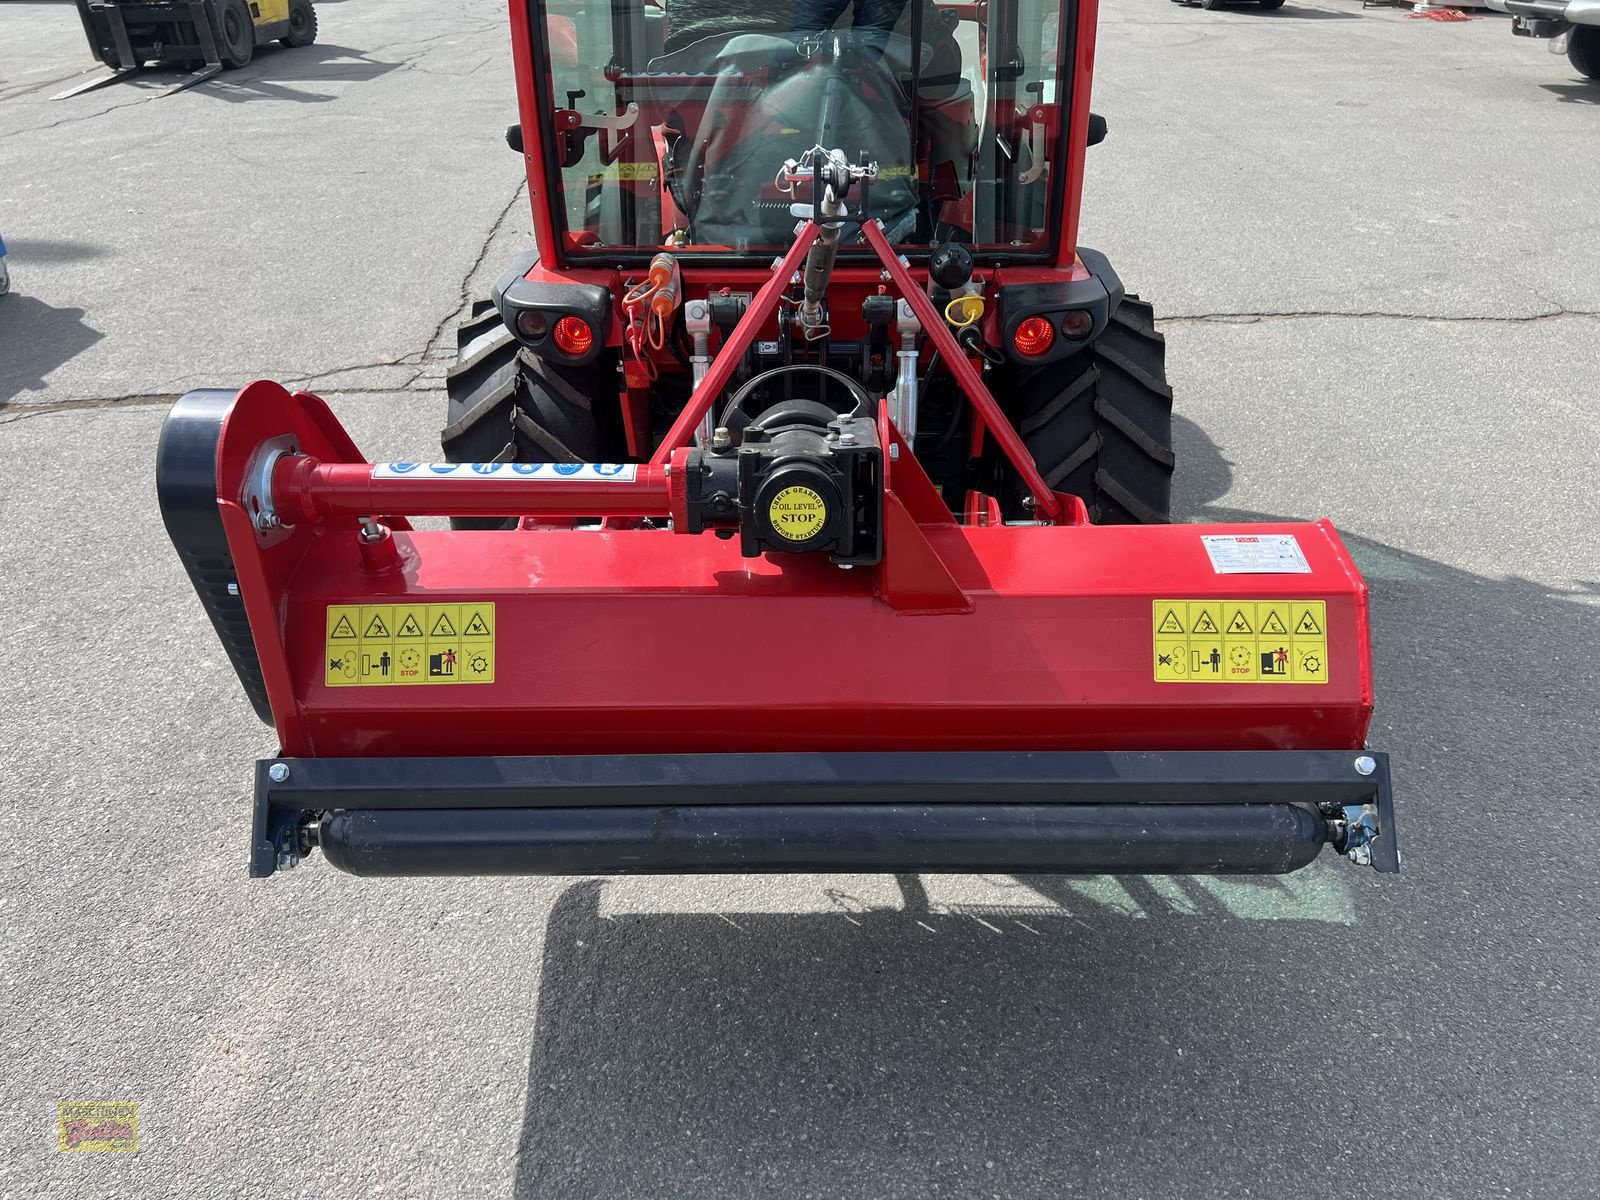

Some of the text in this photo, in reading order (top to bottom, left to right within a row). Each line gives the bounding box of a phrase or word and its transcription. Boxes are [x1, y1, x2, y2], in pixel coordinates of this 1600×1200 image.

[772, 487, 824, 510] CHECK GEARBOX
[781, 514, 816, 523] STOP
[772, 519, 794, 539] BEFORE
